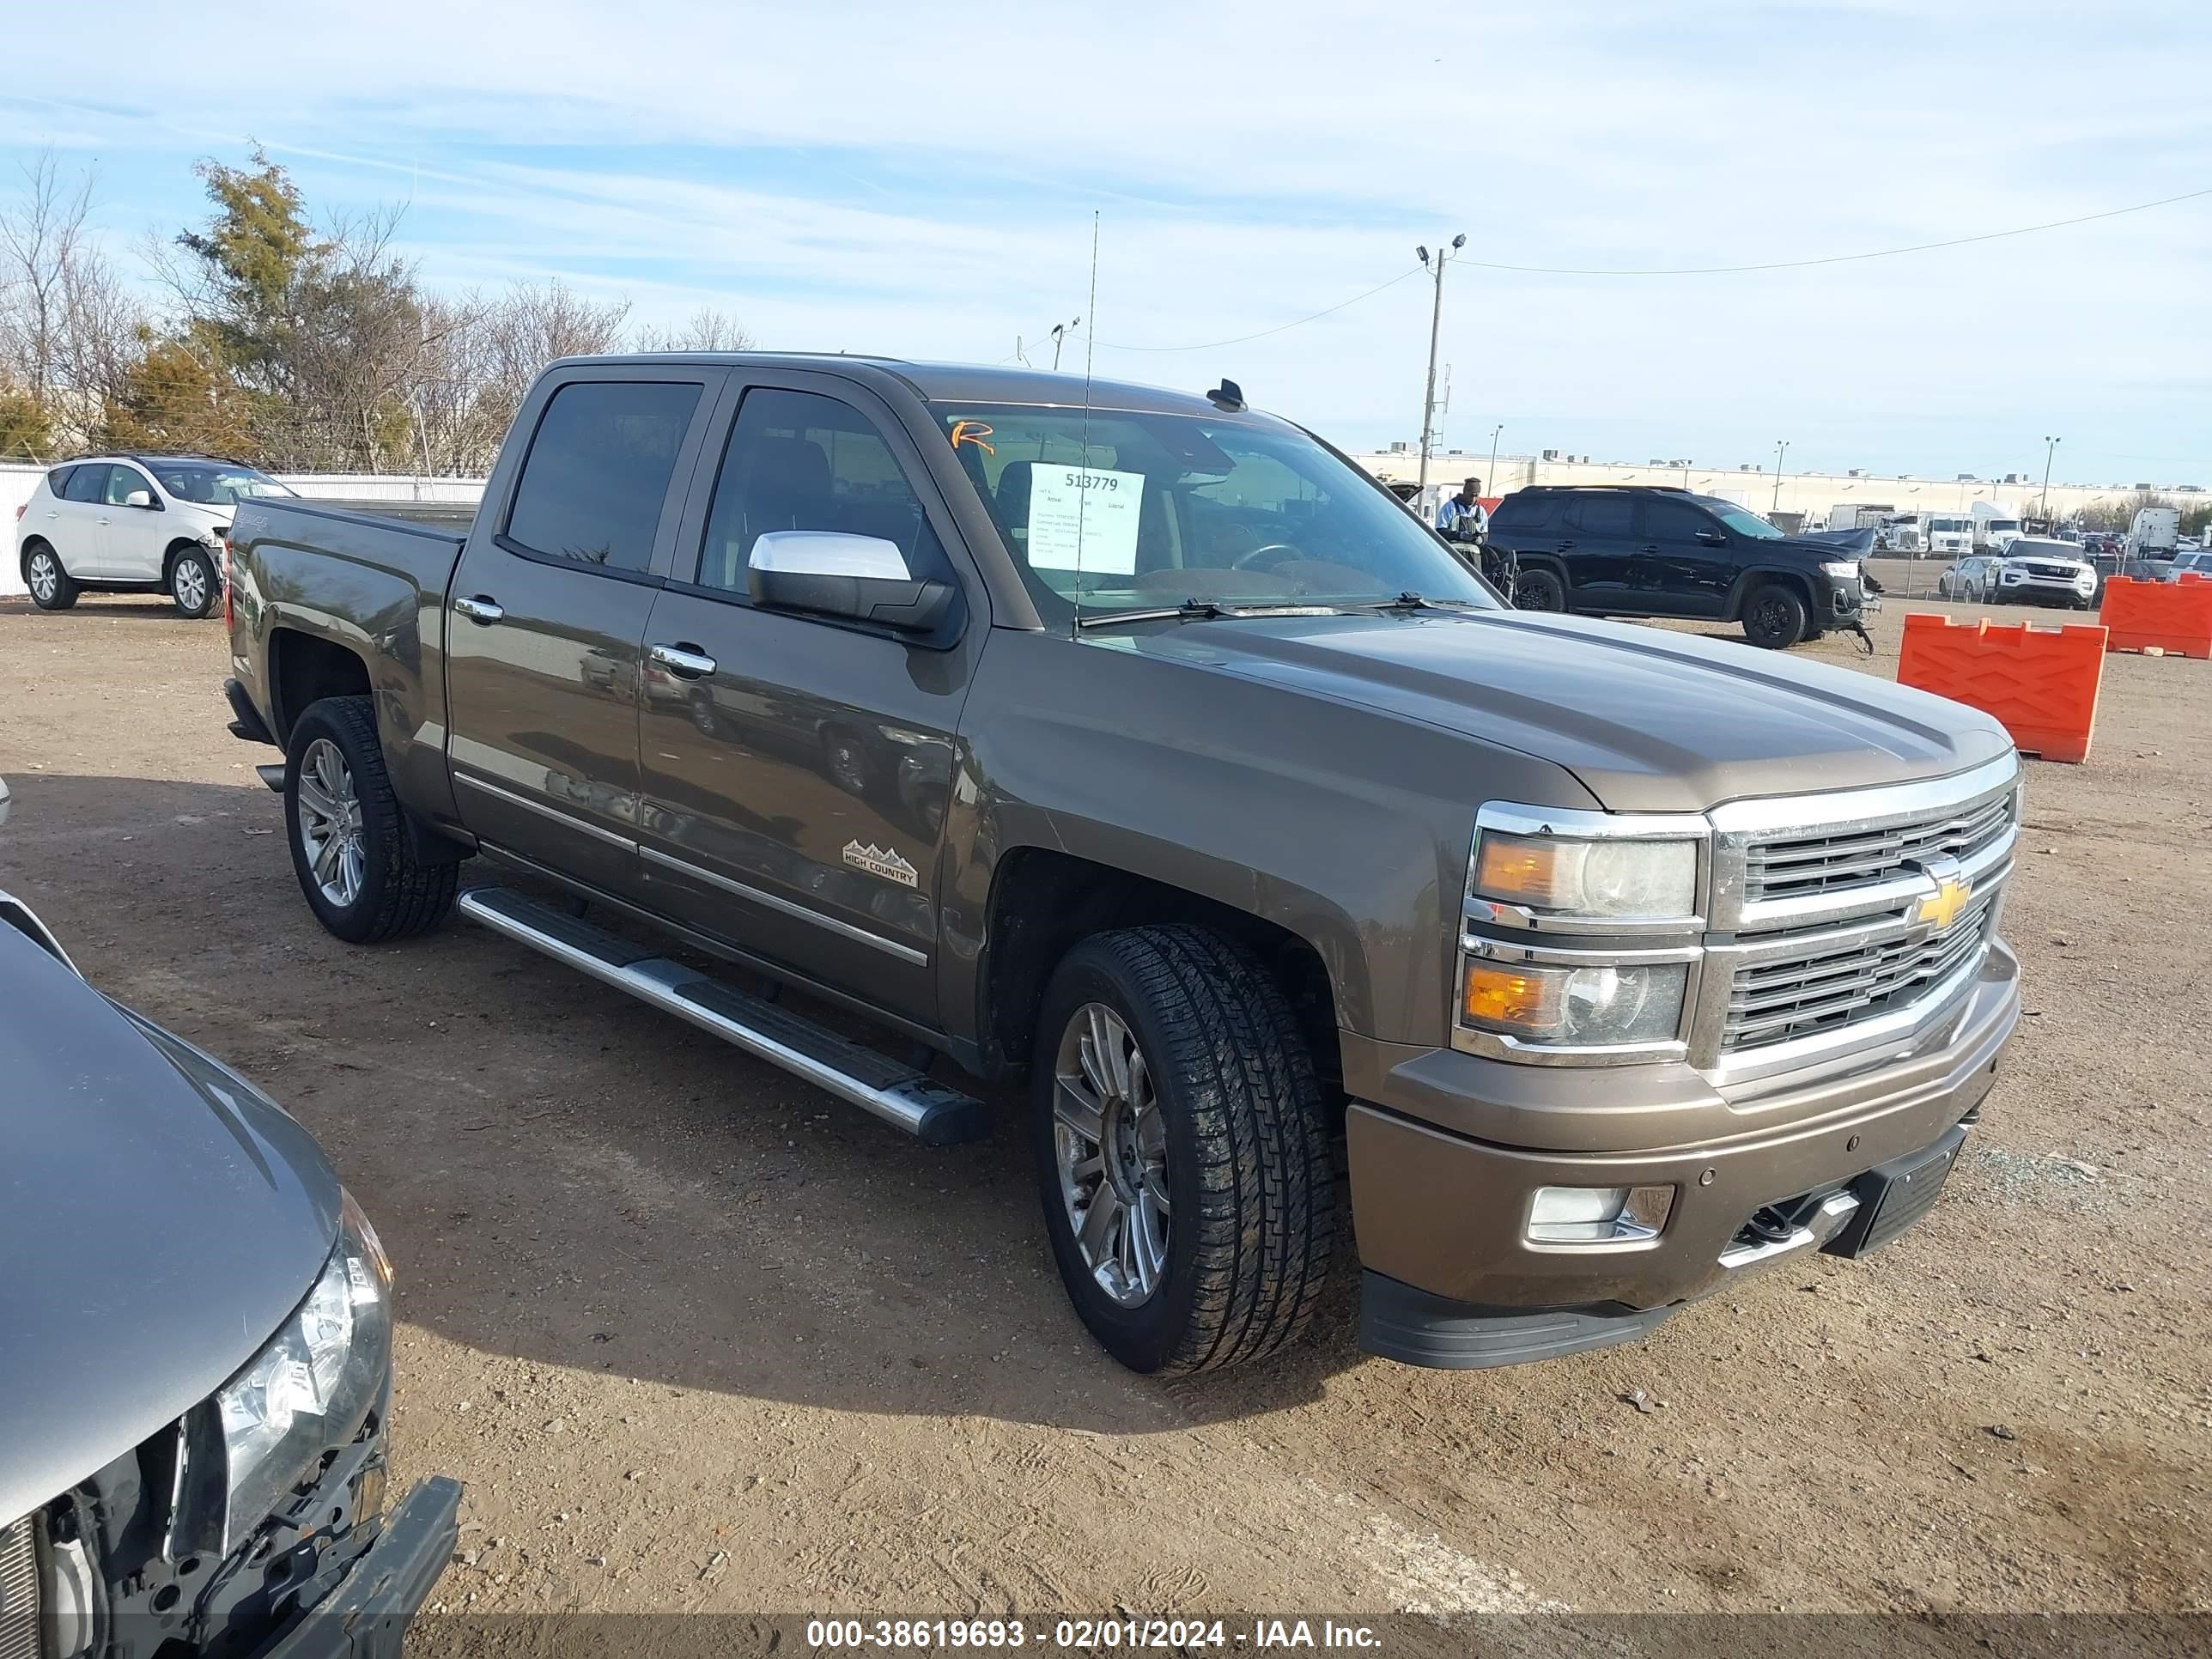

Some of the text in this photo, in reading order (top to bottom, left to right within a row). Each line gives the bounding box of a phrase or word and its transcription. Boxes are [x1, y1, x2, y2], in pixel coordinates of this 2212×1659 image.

[951, 421, 995, 456] R
[1065, 473, 1119, 491] 513779
[845, 853, 914, 883] HIGH COUNTRY
